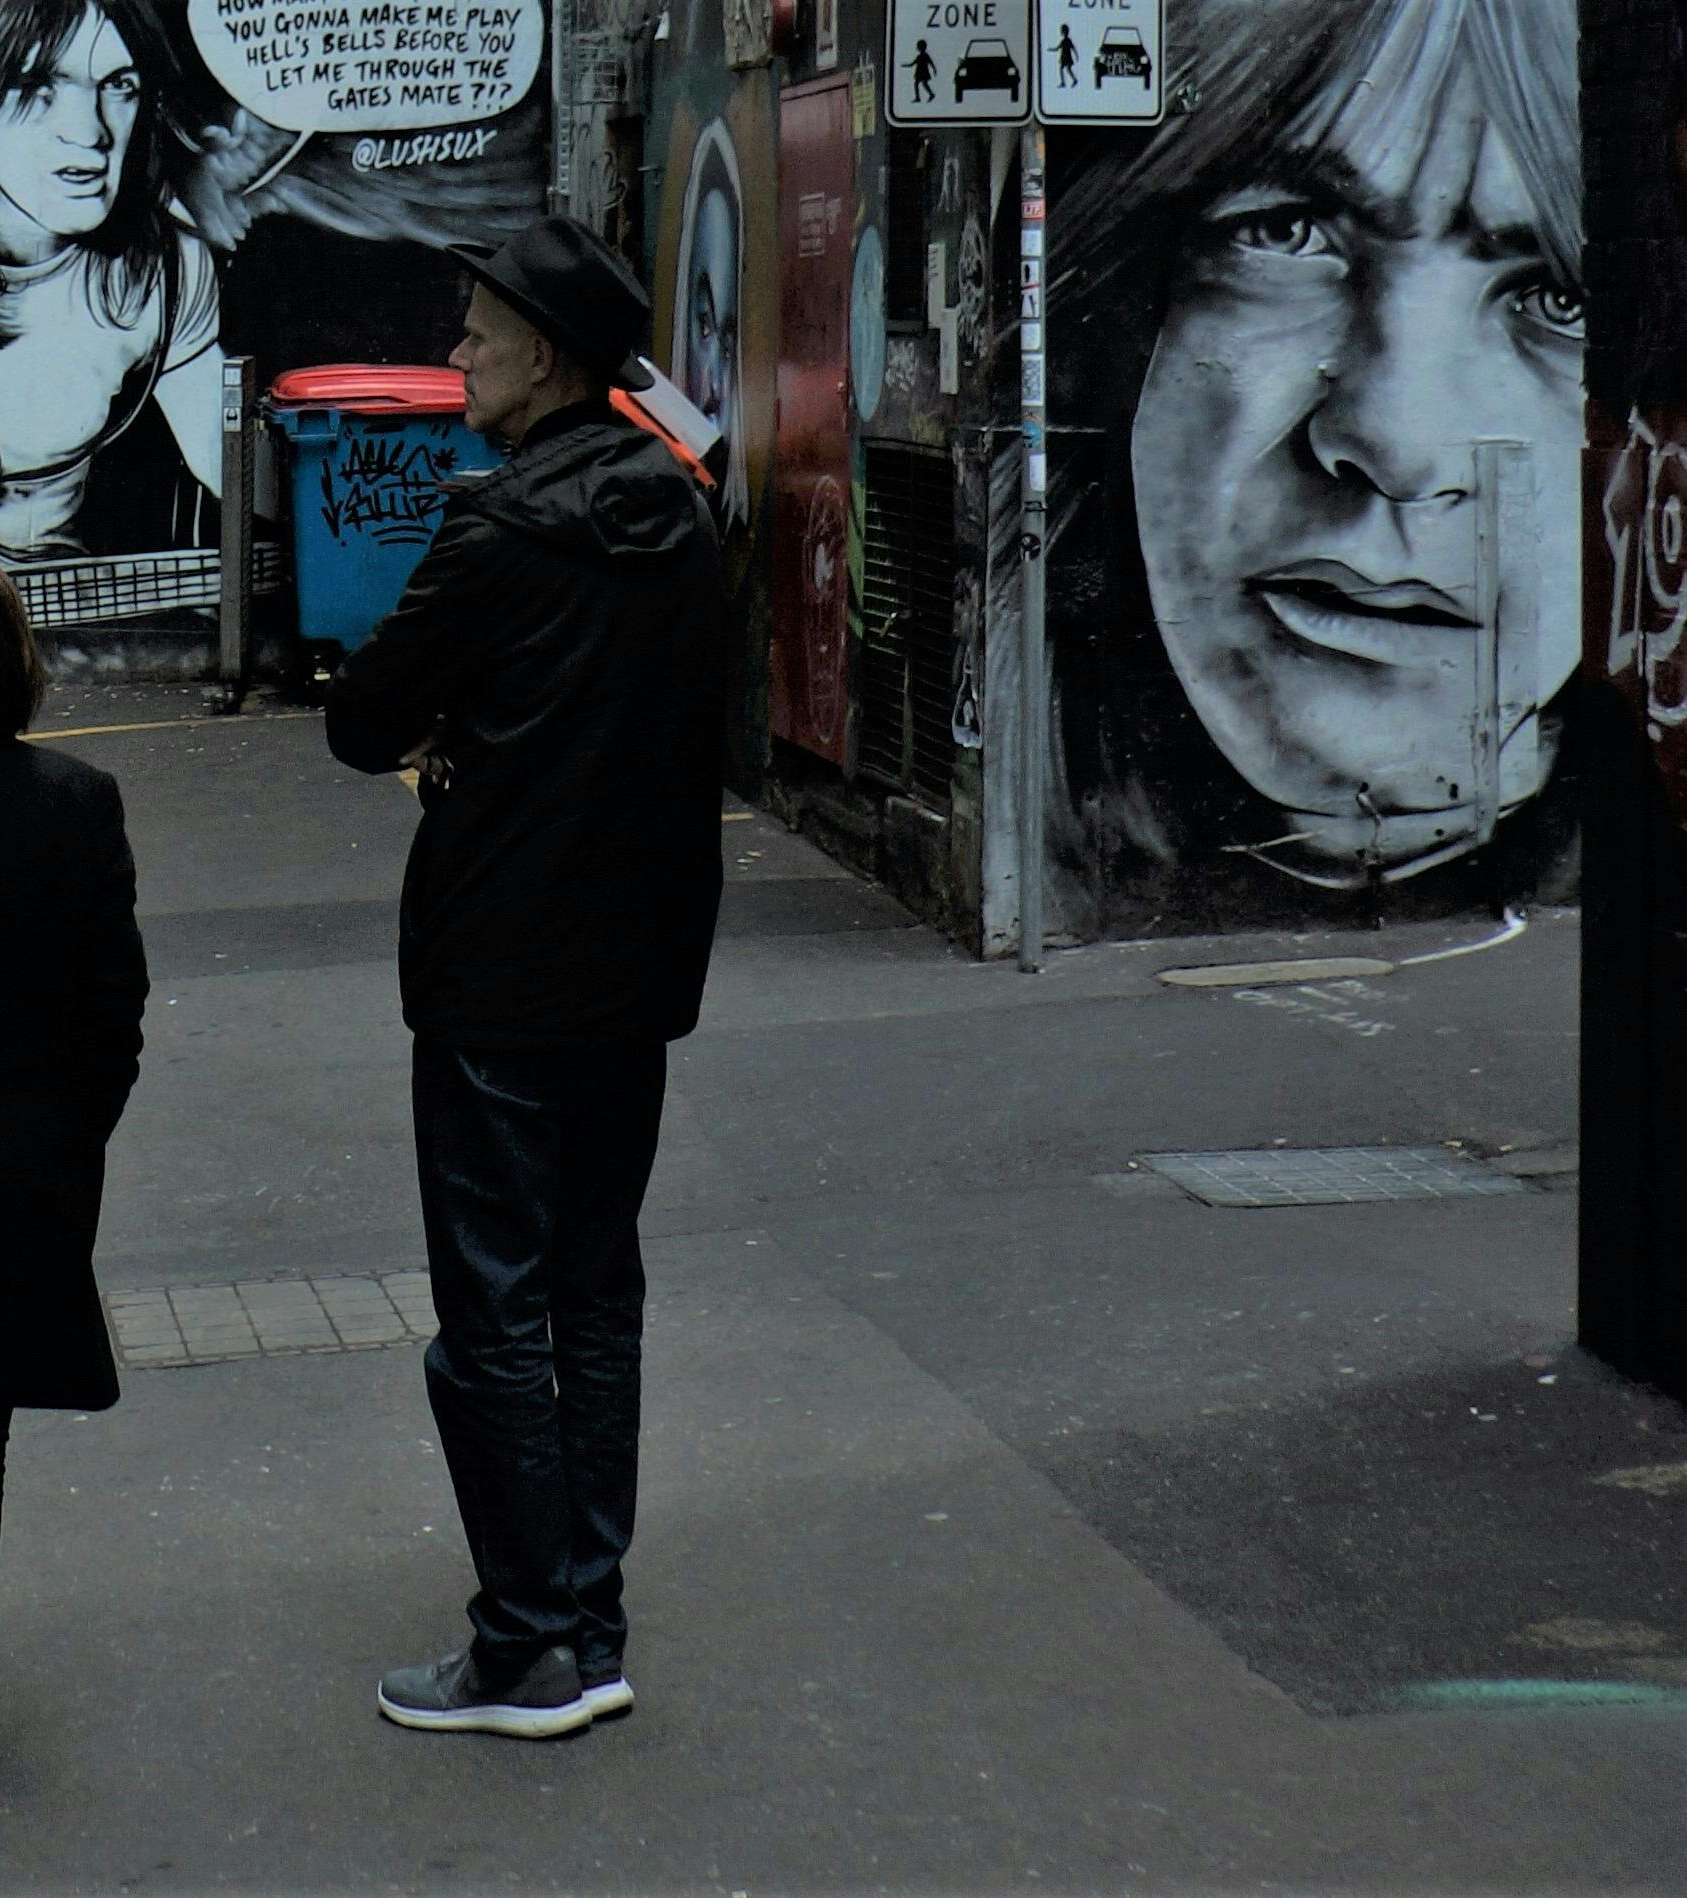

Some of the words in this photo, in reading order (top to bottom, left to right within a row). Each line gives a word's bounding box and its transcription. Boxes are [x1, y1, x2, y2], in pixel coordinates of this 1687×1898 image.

[224, 17, 266, 43] YOU
[275, 9, 350, 34] GONNA
[360, 4, 421, 26] MAKE
[426, 6, 458, 26] ME
[465, 8, 522, 32] PLAY
[926, 3, 997, 28] ZONE
[246, 36, 310, 66] HELL'S
[322, 29, 385, 55] BELLS
[393, 29, 469, 53] BEFORE
[479, 31, 515, 54] YOU
[265, 65, 305, 91] LET
[312, 62, 348, 84] ME
[354, 58, 455, 81] THROUGH
[463, 58, 509, 79] THE
[327, 85, 392, 112] GATES
[401, 83, 462, 106] MATE
[351, 127, 498, 172] @LUSHSUX
